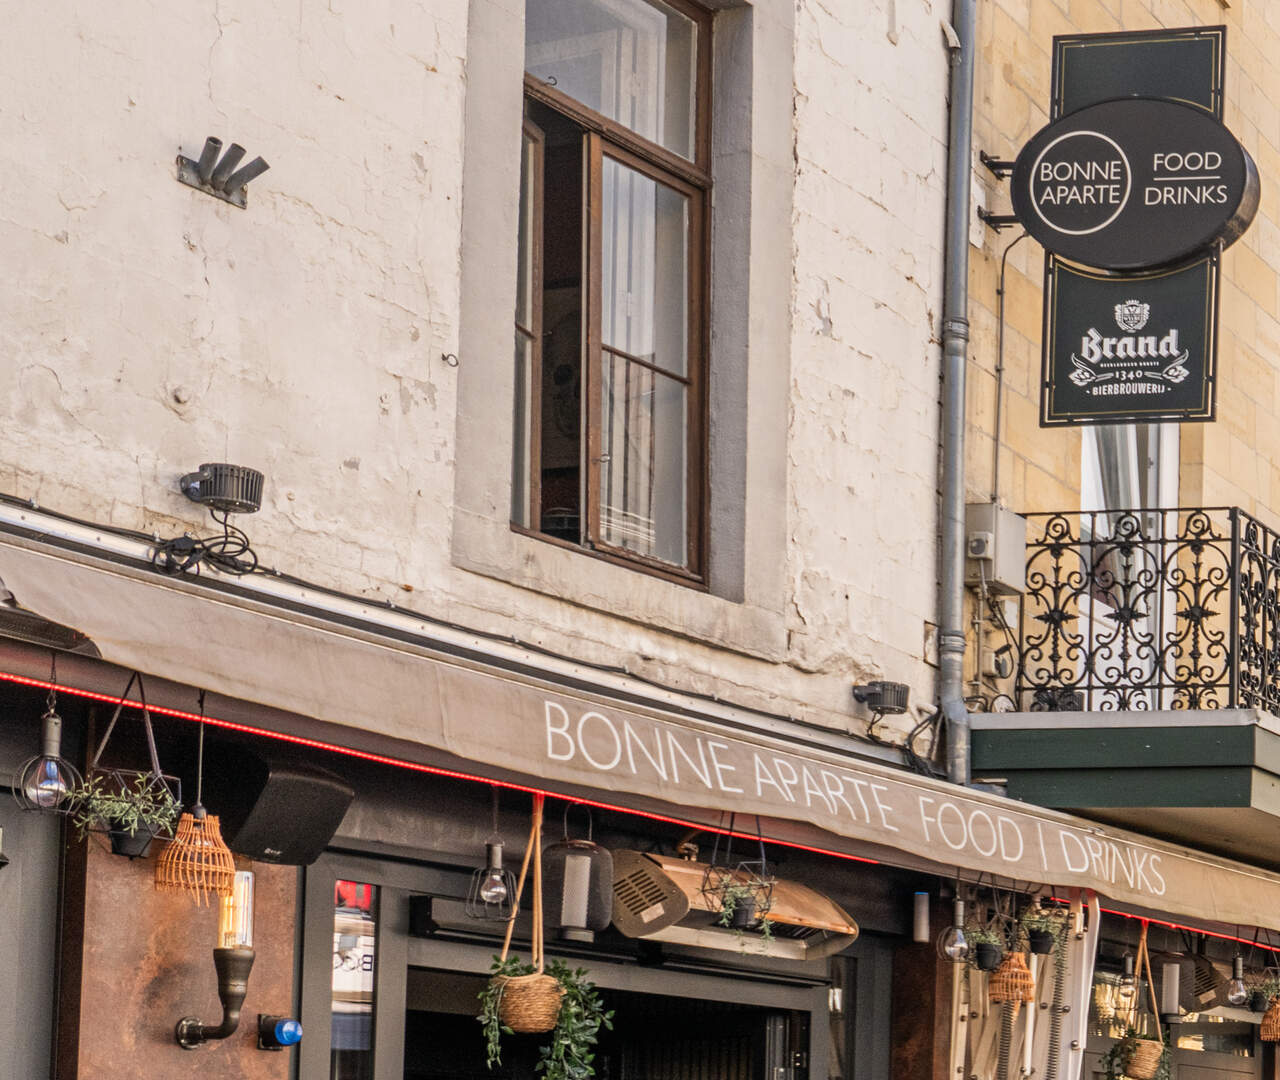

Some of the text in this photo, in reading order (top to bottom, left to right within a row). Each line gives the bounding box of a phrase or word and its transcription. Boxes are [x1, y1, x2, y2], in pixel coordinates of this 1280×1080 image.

[1040, 161, 1121, 181] BONNE
[1153, 152, 1222, 172] FOOD
[1040, 185, 1120, 205] APARTE
[1144, 185, 1228, 206] DRINKS
[1081, 328, 1180, 364] Brand
[1115, 371, 1143, 381] 1340
[1092, 382, 1165, 395] BIERBROUWERIJ
[545, 701, 744, 793] BONNE
[754, 752, 899, 833] APARTE
[919, 796, 1024, 861] FOOD
[1060, 830, 1166, 896] DRINKS
